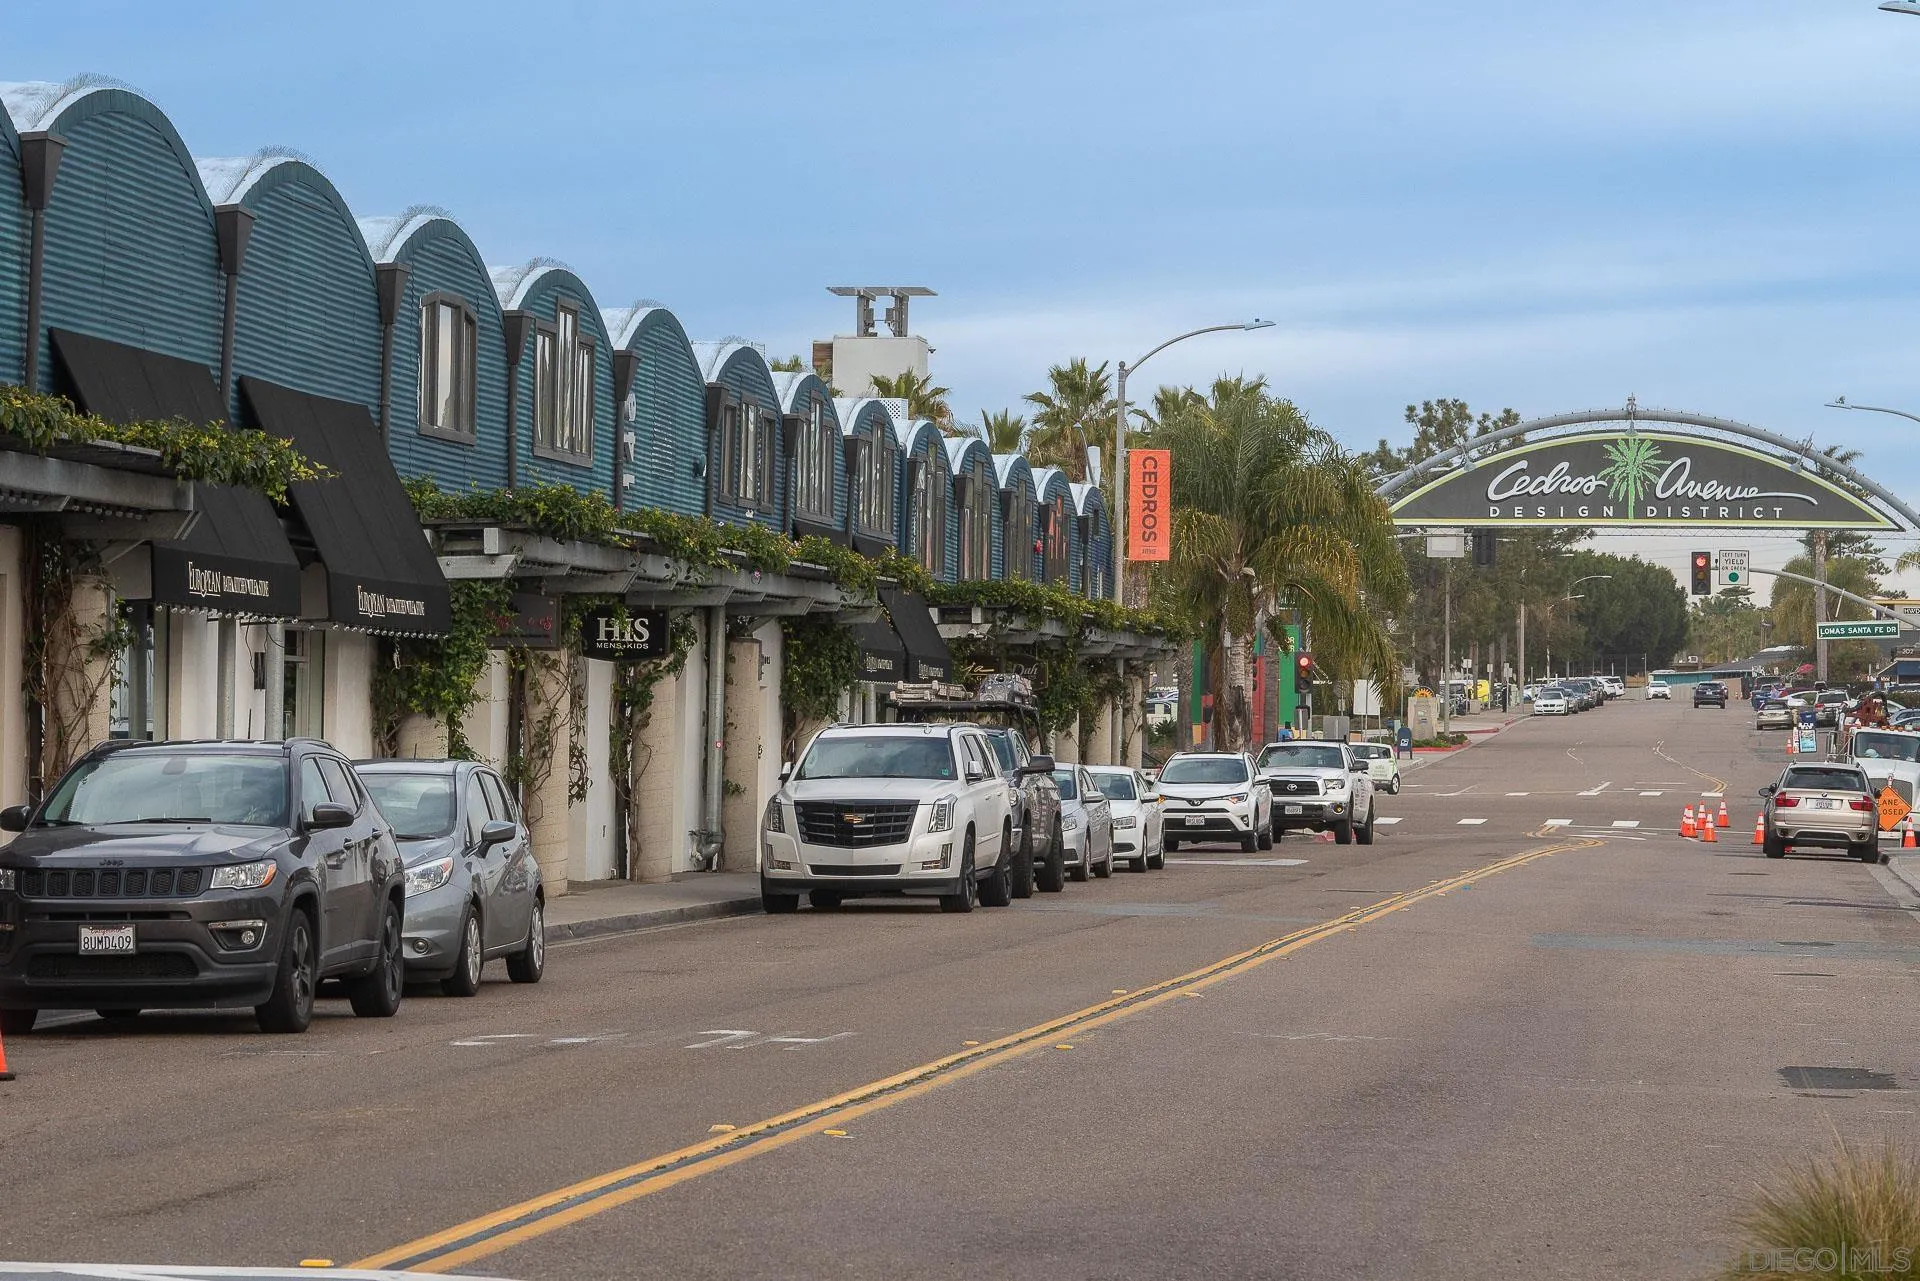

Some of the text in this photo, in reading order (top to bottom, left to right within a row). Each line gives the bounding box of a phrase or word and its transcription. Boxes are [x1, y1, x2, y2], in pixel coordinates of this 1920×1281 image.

[1487, 457, 1818, 505] Cedros Avenue
[1142, 456, 1158, 542] CEDROS
[1489, 506, 1784, 518] DESIGN DISTRICT
[1820, 627, 1845, 635] LOMAS
[1848, 626, 1872, 634] SANTA
[83, 935, 132, 950] 8UMD409
